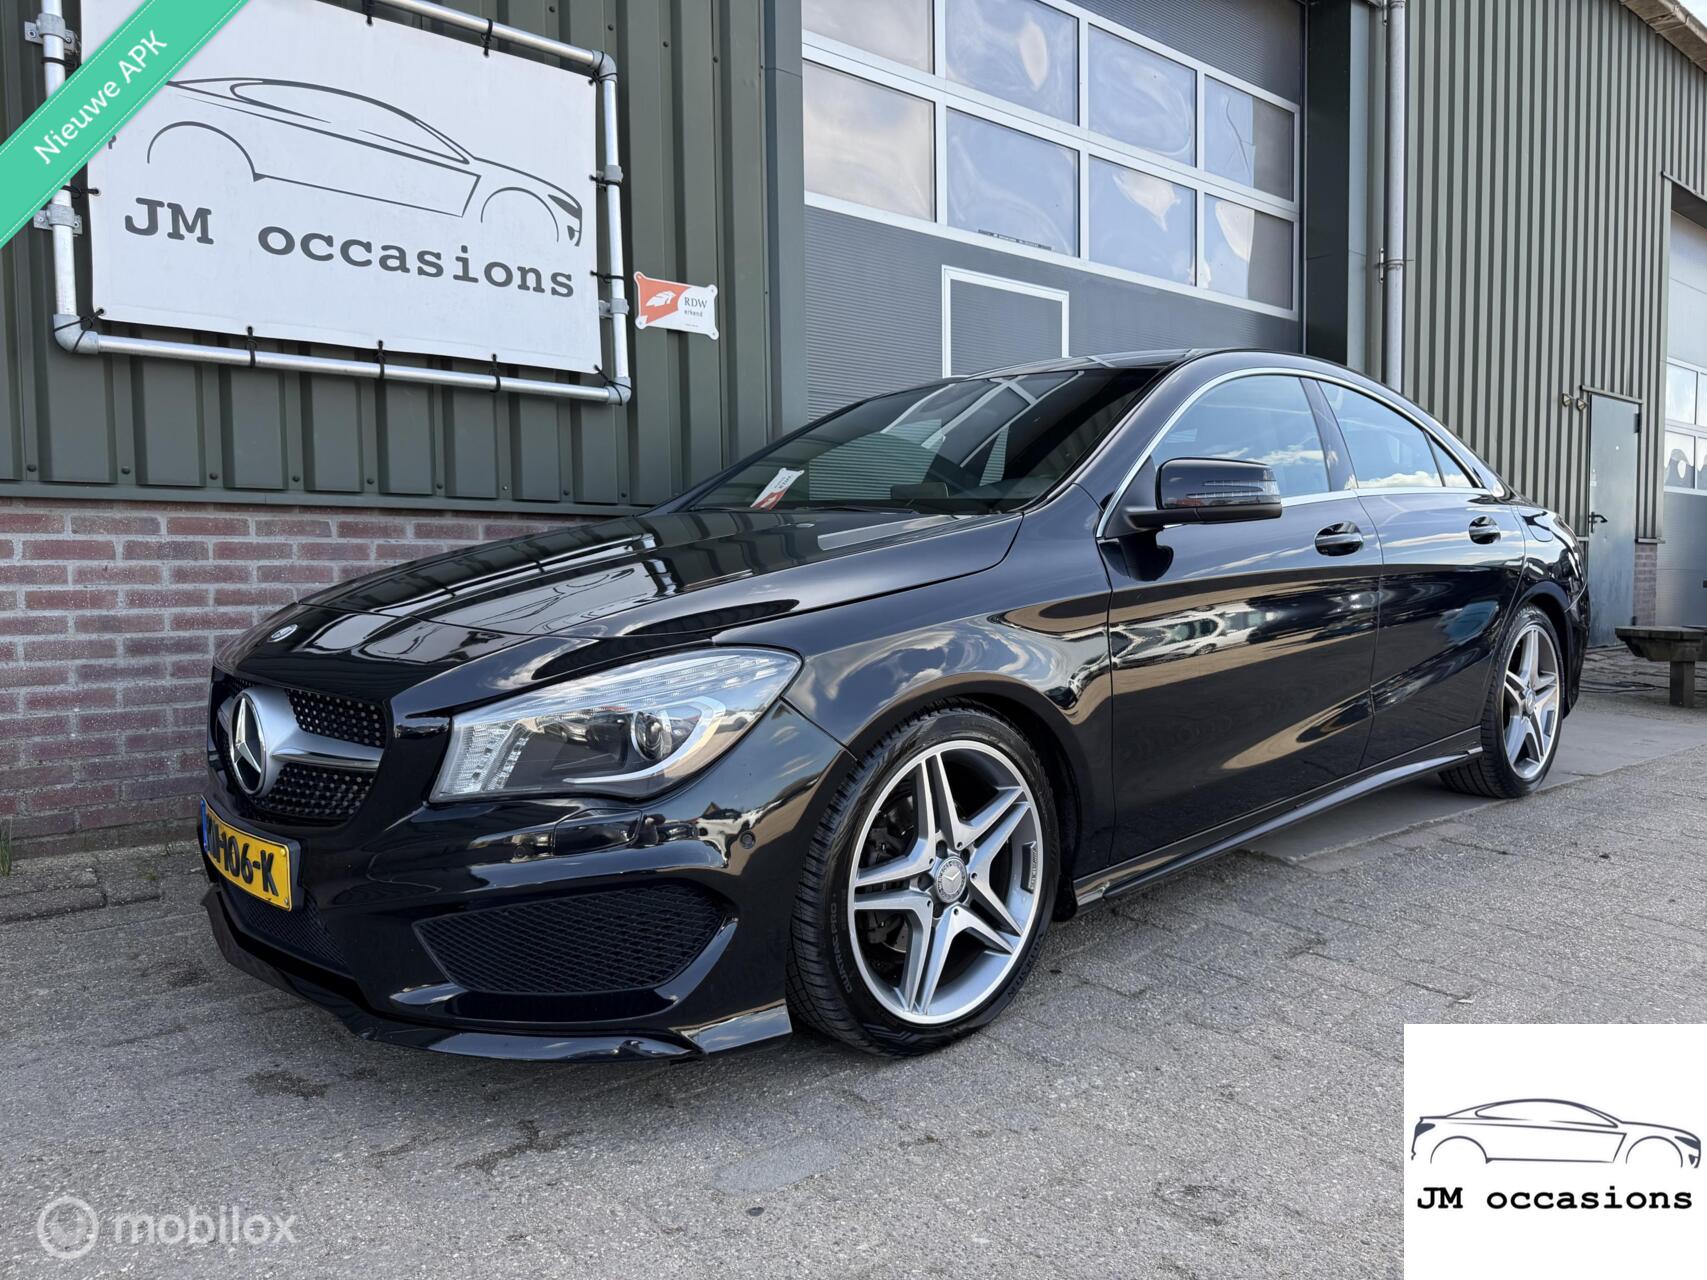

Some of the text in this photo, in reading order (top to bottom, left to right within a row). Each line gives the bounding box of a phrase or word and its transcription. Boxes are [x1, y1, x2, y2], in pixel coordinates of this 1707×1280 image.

[124, 197, 574, 298] JM occasions
[684, 296, 708, 309] RDW
